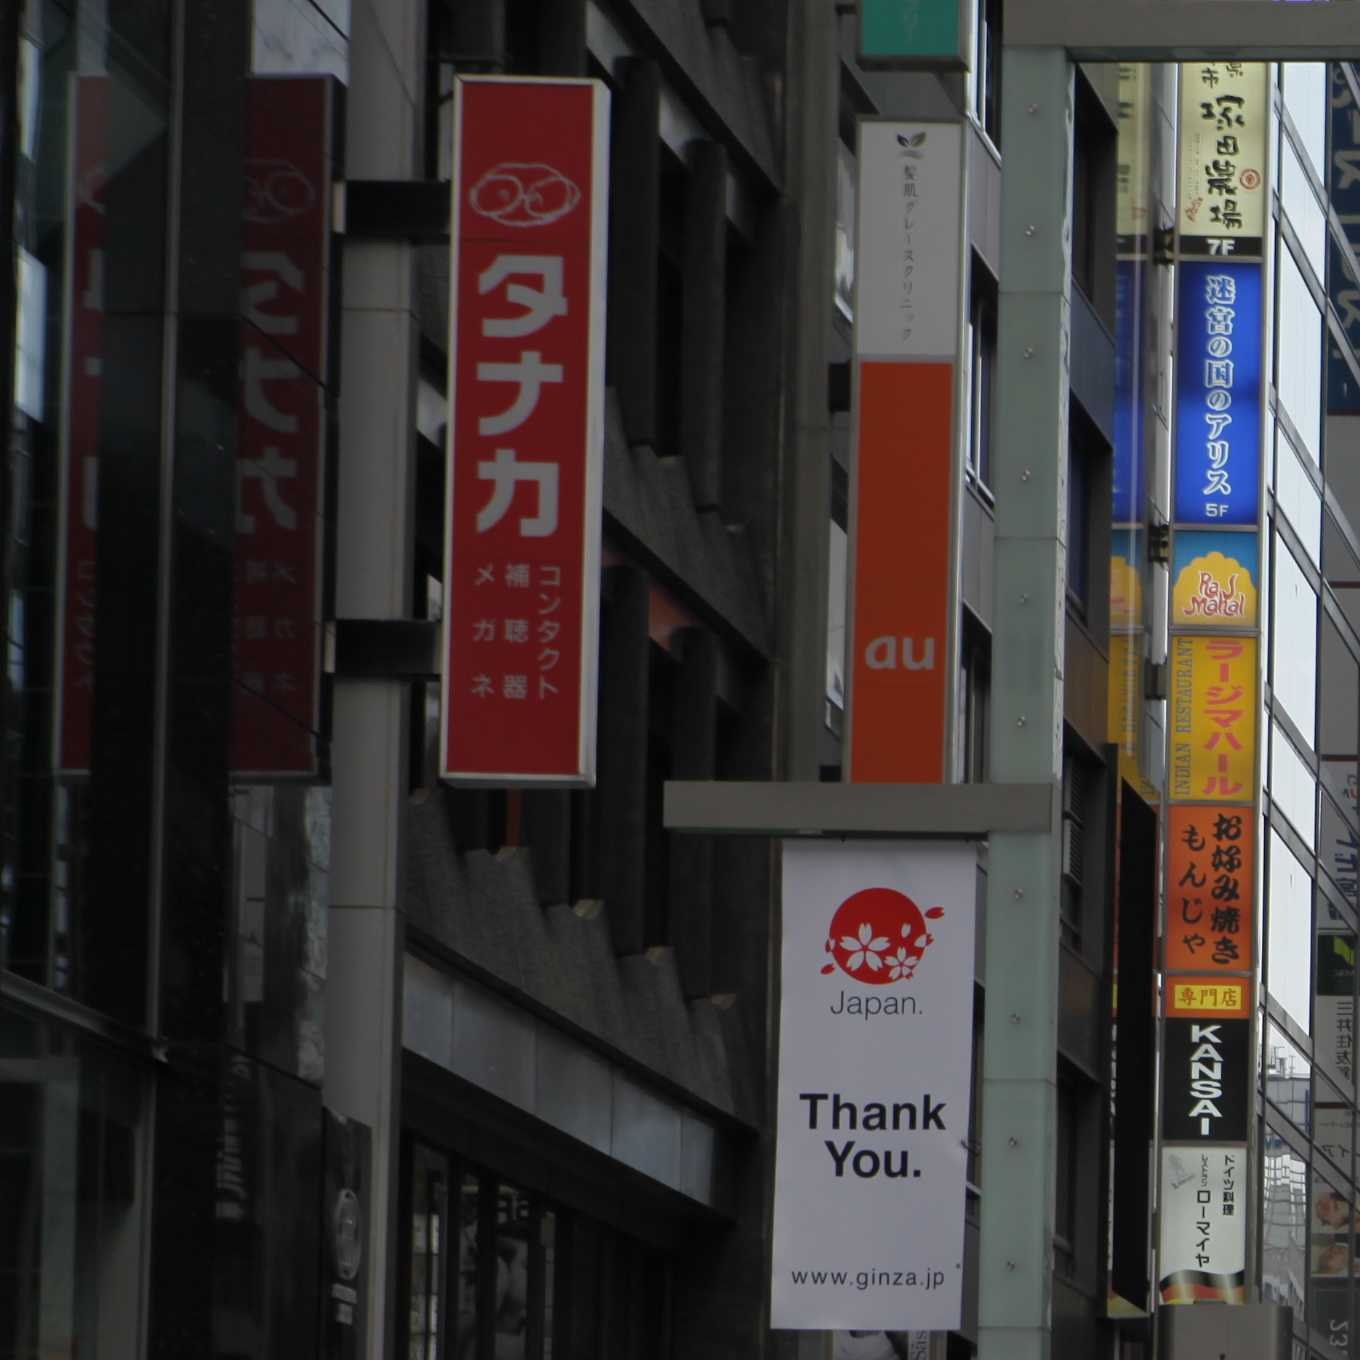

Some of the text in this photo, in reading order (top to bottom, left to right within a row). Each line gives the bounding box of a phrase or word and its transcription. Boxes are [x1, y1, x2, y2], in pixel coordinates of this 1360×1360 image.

[1200, 95, 1245, 229] 塚田農場
[1206, 238, 1236, 256] 7F
[477, 255, 568, 538] タナカ
[1204, 274, 1236, 496] 迷宮の国のアリス
[1205, 503, 1228, 517] 5F
[470, 564, 495, 699] メガネ
[503, 563, 530, 701] 補聴器
[537, 564, 562, 699] コンタクト
[865, 636, 935, 670] au
[1184, 593, 1246, 618] Mahal
[1175, 638, 1193, 796] INDIAN RESTAURANT
[1203, 640, 1246, 794] ラージマハール
[1178, 826, 1205, 953] もんじゃ
[1210, 814, 1243, 964] お好み焼き
[829, 990, 924, 1019] Japan.
[1177, 987, 1240, 1008] 専門店
[801, 1094, 947, 1131] Thank
[1188, 1024, 1224, 1136] KANSAI
[824, 1140, 923, 1179] You.
[791, 1266, 945, 1291] www.ginza.jp
[1196, 1190, 1211, 1267] ローマイヤ
